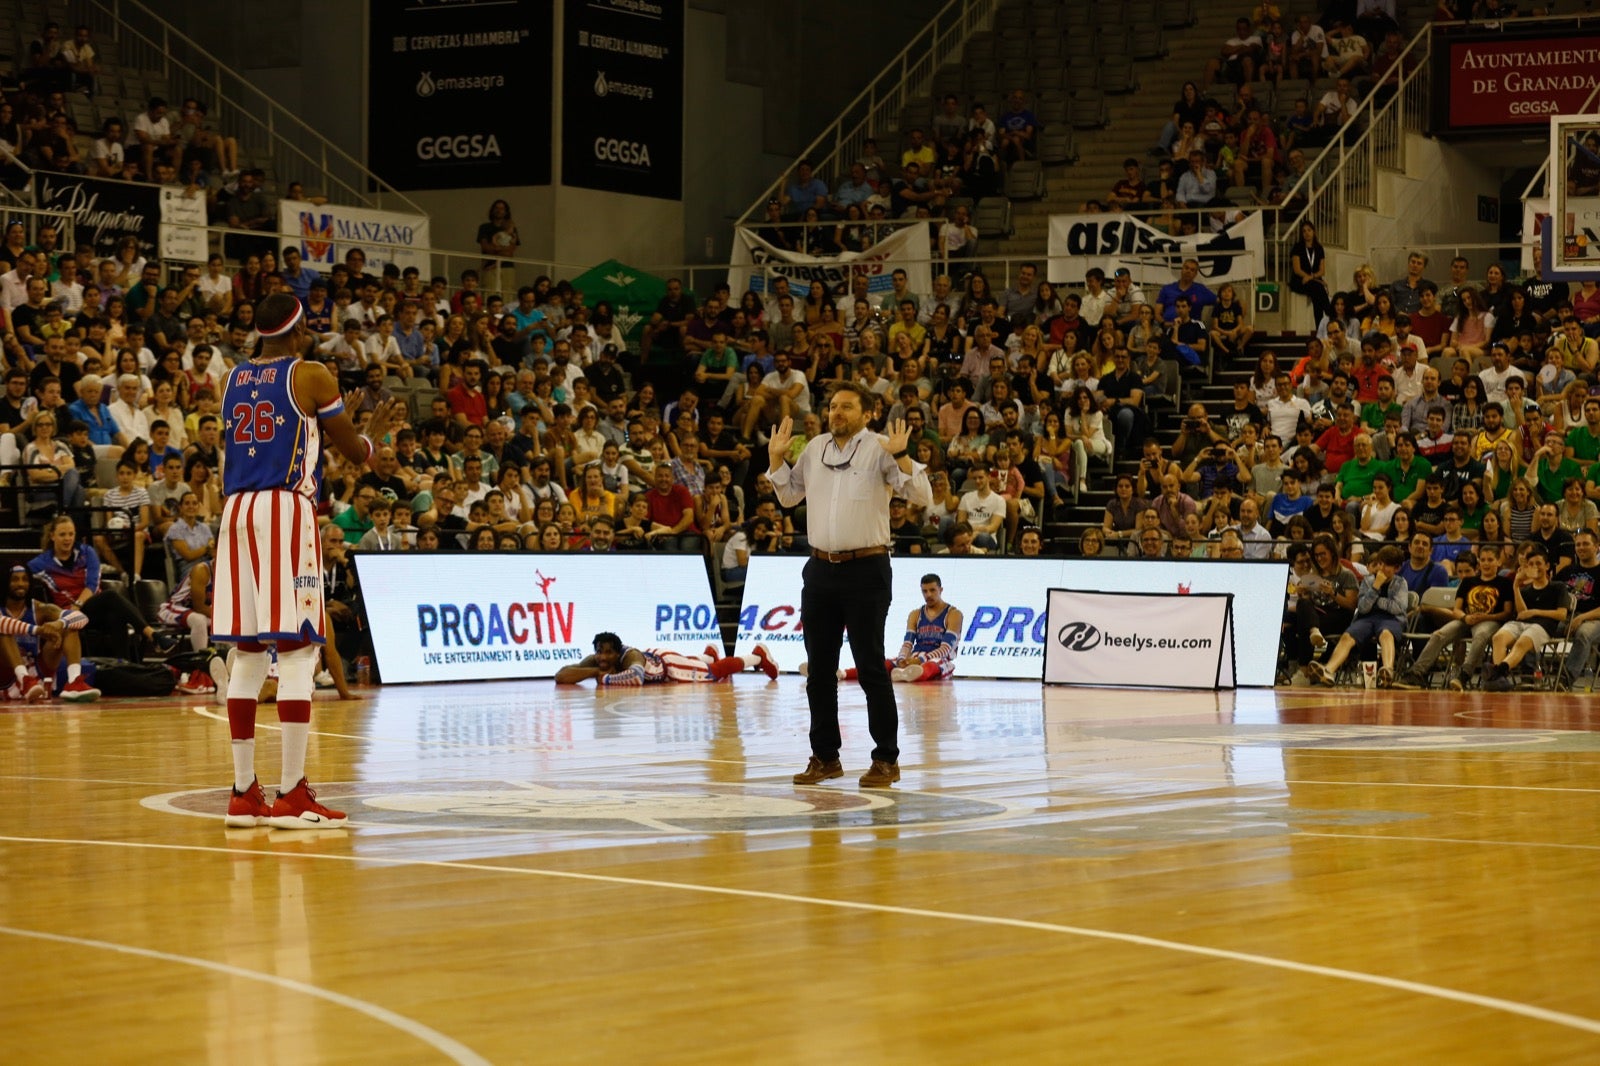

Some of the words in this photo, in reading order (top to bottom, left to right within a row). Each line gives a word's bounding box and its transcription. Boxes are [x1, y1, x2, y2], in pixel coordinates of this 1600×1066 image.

[411, 34, 461, 50] CERVEZAS
[462, 30, 520, 48] ALHAMBRA
[591, 33, 625, 53] CERVEZAS
[625, 40, 663, 60] ALHAMBRA
[1460, 49, 1600, 70] AYUNTAMIENT
[436, 75, 505, 91] emasagra
[608, 81, 654, 100] emasagra
[1472, 80, 1498, 94] DE
[1503, 72, 1598, 92] GRANADA
[337, 219, 414, 246] MANZANO
[1258, 292, 1274, 311] D
[232, 400, 276, 445] 26
[417, 602, 574, 648] PROACTIV
[655, 604, 721, 632] PRO
[656, 633, 671, 642] LIVE
[673, 633, 724, 641] ENTERTAINME
[1104, 631, 1212, 651] heelys.eu.com
[424, 652, 442, 665] LIVE
[445, 650, 512, 664] ENTERTAINMENT
[515, 650, 522, 662] &
[523, 648, 551, 661] BRAND
[552, 648, 583, 660] EVENTS
[960, 646, 987, 656] LIVE
[989, 646, 1045, 658] ENTERTA
